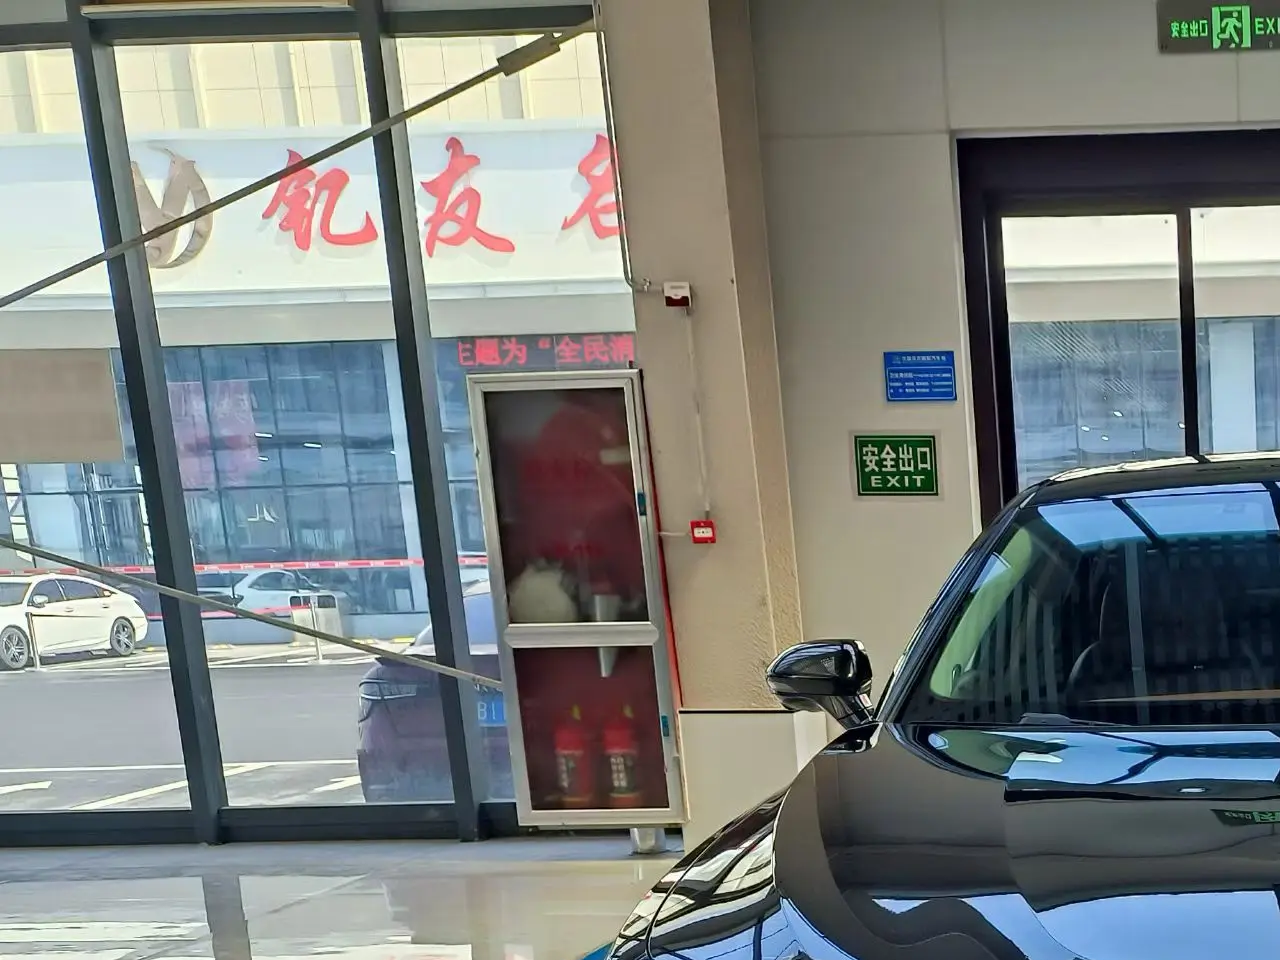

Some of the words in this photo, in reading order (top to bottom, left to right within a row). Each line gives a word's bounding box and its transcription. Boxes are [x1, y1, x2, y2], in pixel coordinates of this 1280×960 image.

[1171, 20, 1208, 38] 安全出口
[862, 443, 931, 473] 安全出口
[870, 475, 926, 488] EXIT
